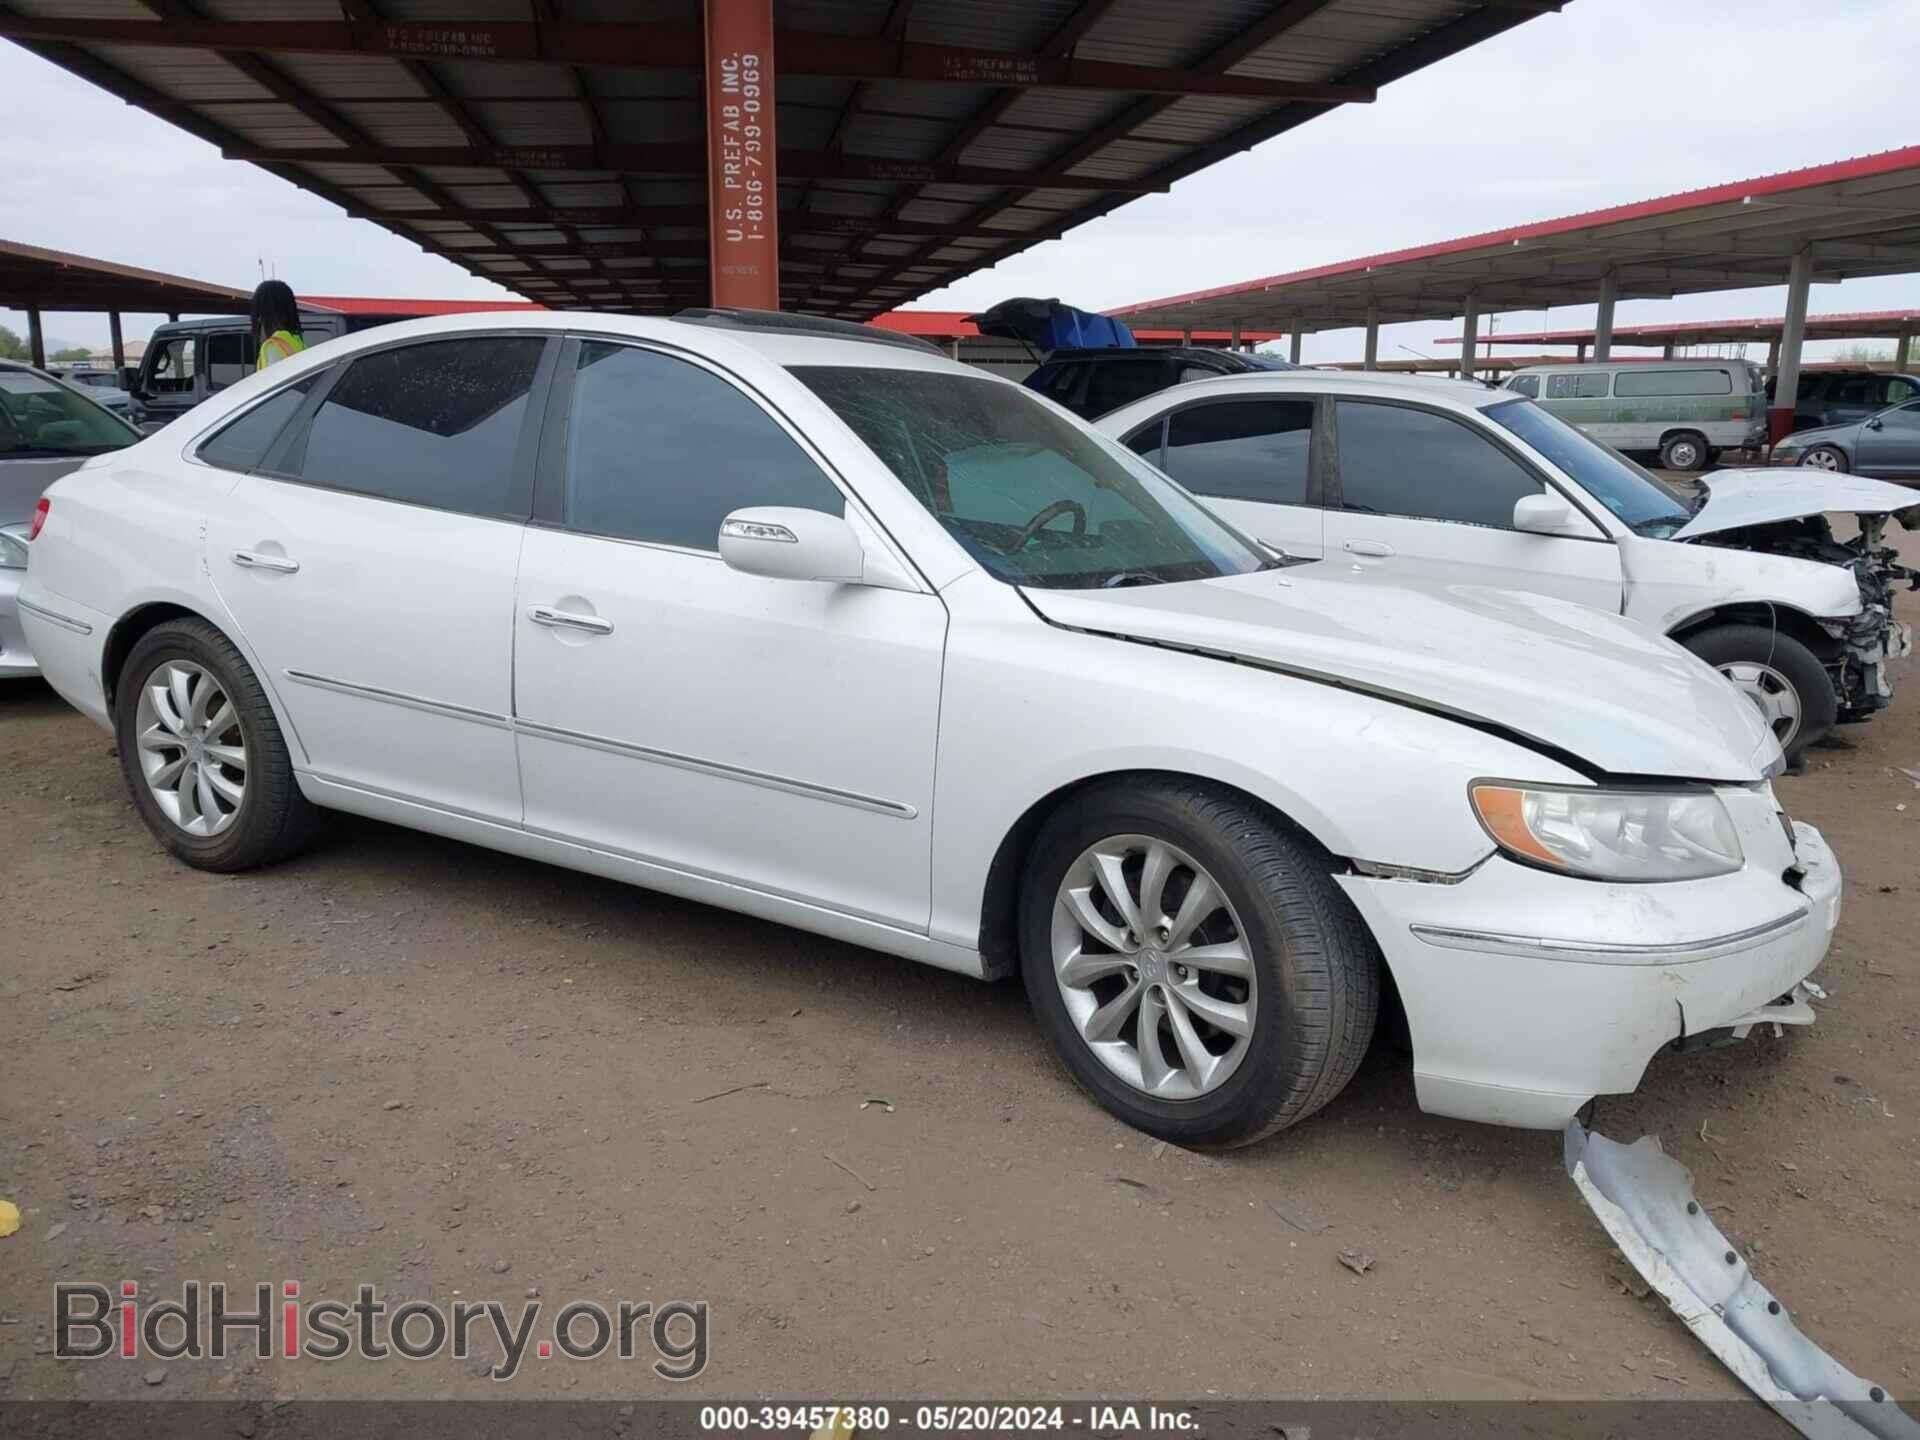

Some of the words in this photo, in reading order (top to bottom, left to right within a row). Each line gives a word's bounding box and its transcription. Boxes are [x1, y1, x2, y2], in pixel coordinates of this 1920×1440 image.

[721, 52, 739, 93] INC.
[723, 104, 742, 189] PREFAB
[742, 54, 765, 240] 1-866-799-0969
[726, 202, 743, 242] U.S.
